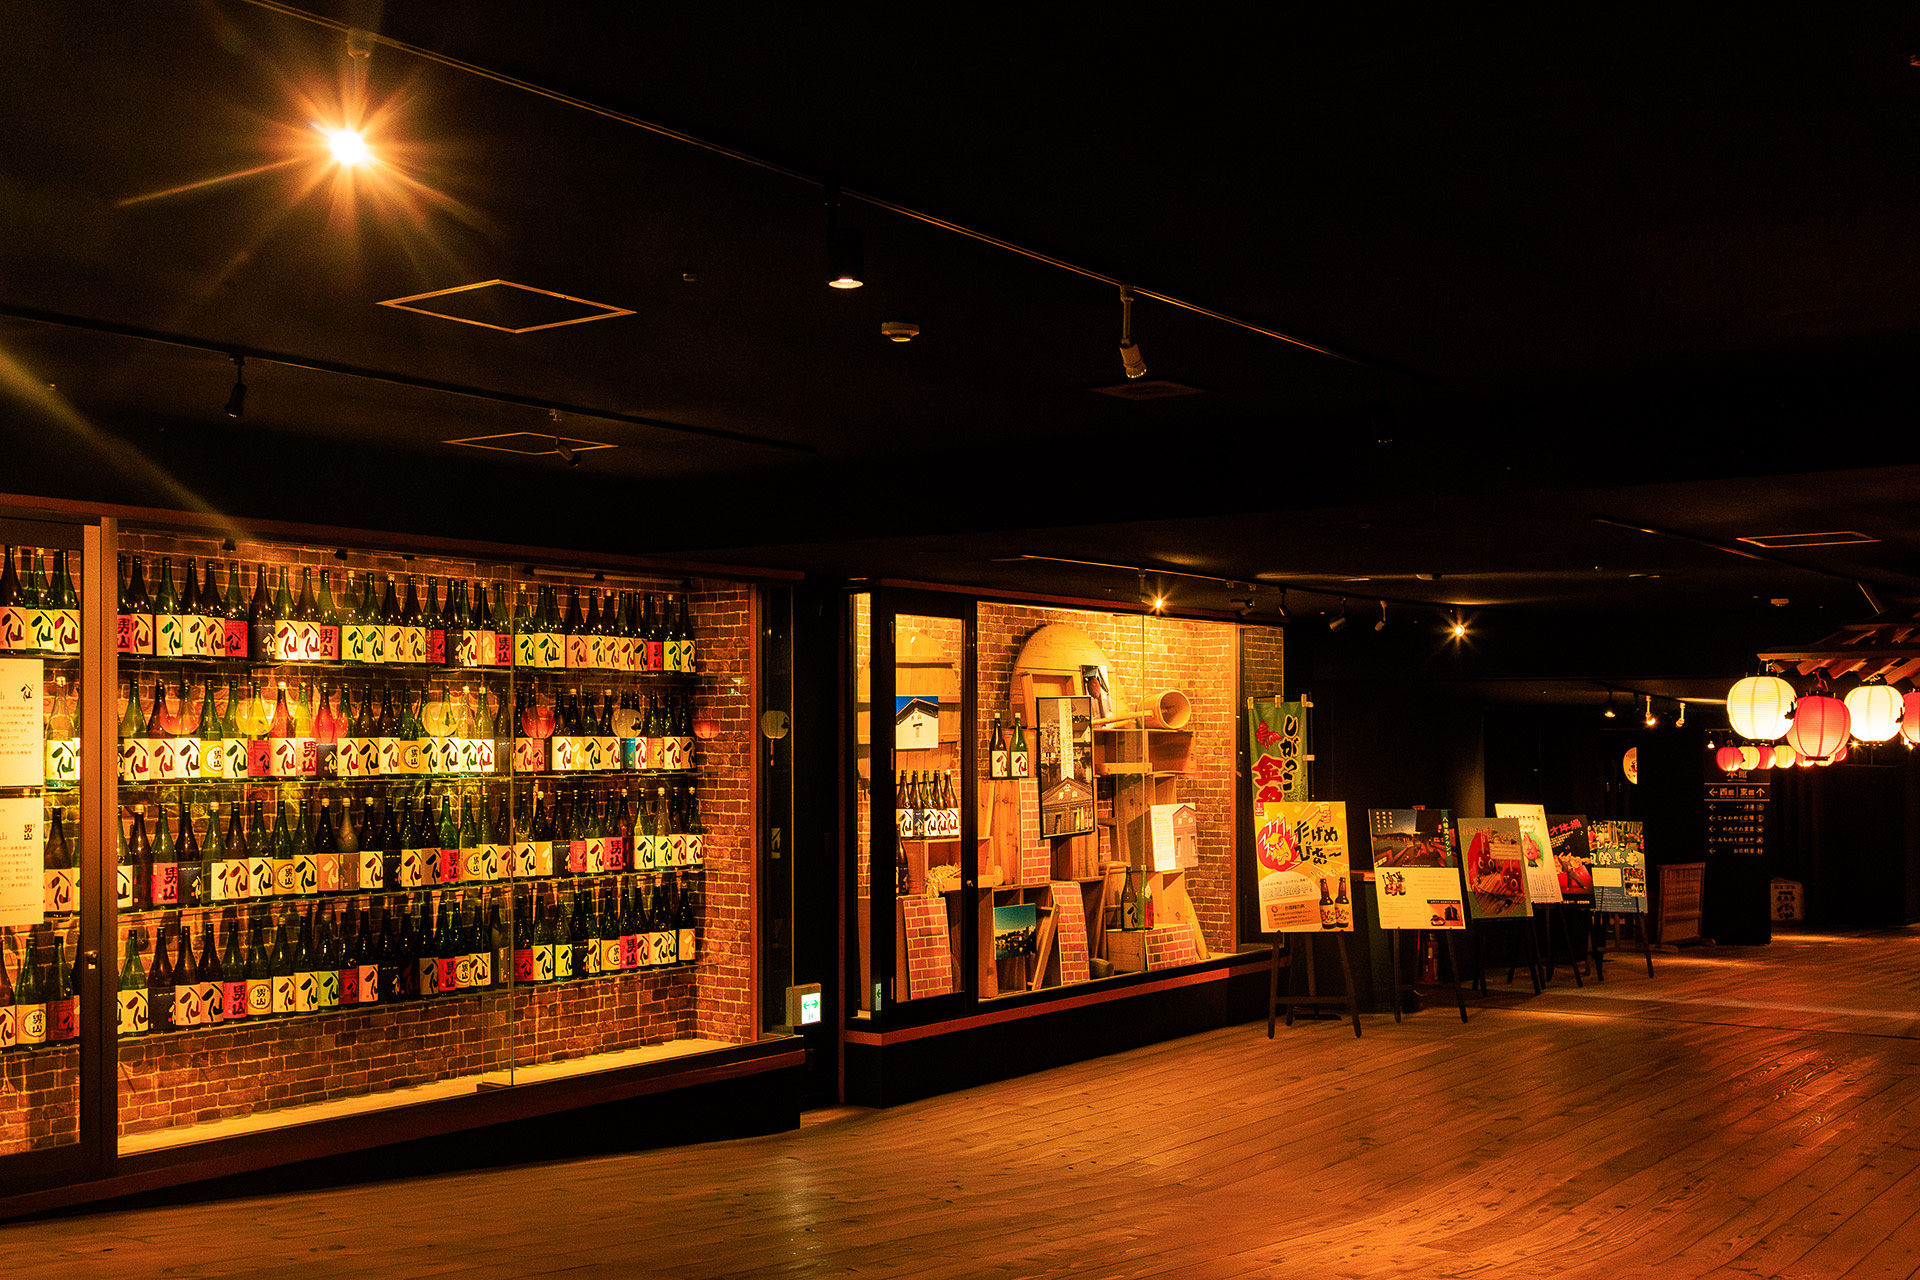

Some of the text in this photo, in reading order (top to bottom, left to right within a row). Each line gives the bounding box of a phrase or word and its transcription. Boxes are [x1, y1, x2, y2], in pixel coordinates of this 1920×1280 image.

[1278, 714, 1300, 792] しがっこ
[1294, 820, 1338, 844] たげめ
